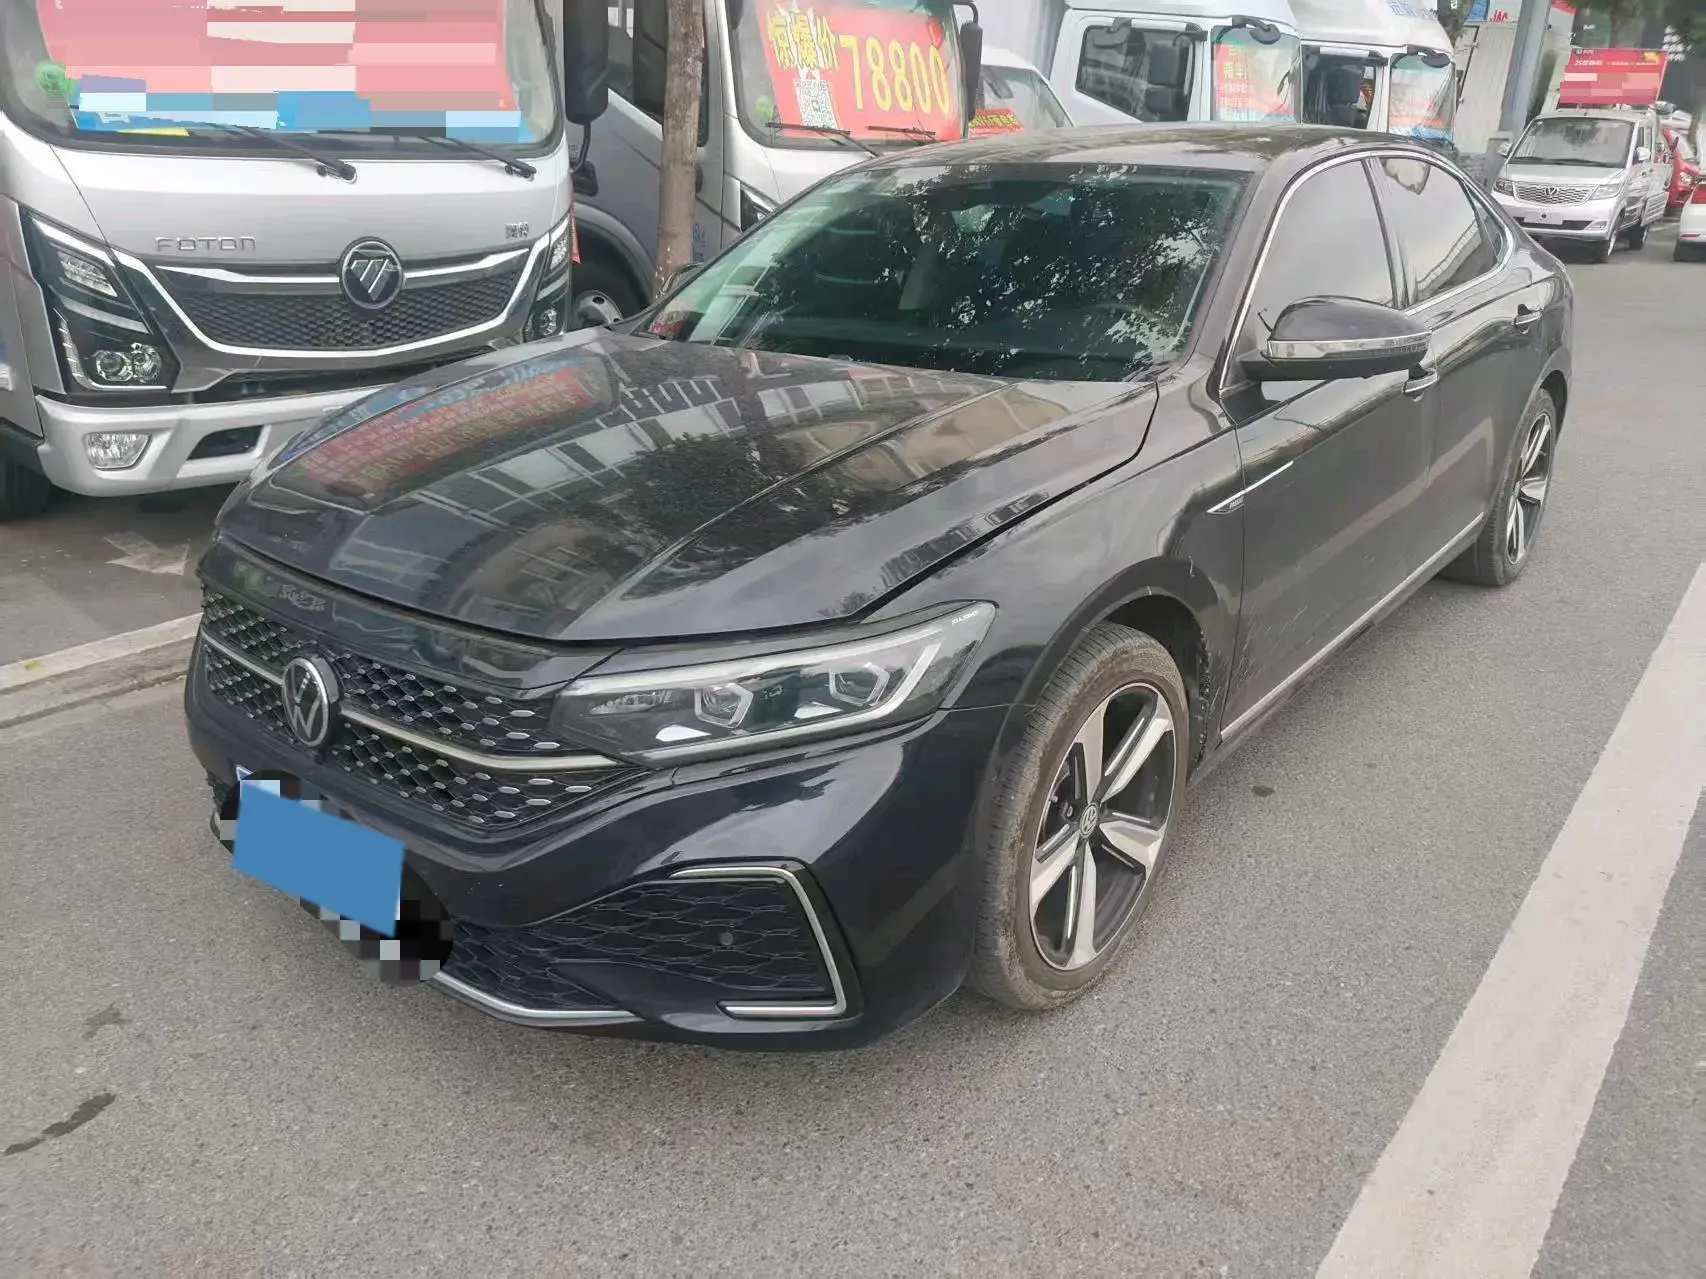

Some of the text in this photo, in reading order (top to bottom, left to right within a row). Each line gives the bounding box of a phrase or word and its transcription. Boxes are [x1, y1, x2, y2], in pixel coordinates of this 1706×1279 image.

[767, 10, 950, 114] 惊爆价 78800
[155, 235, 256, 252] FOTON
